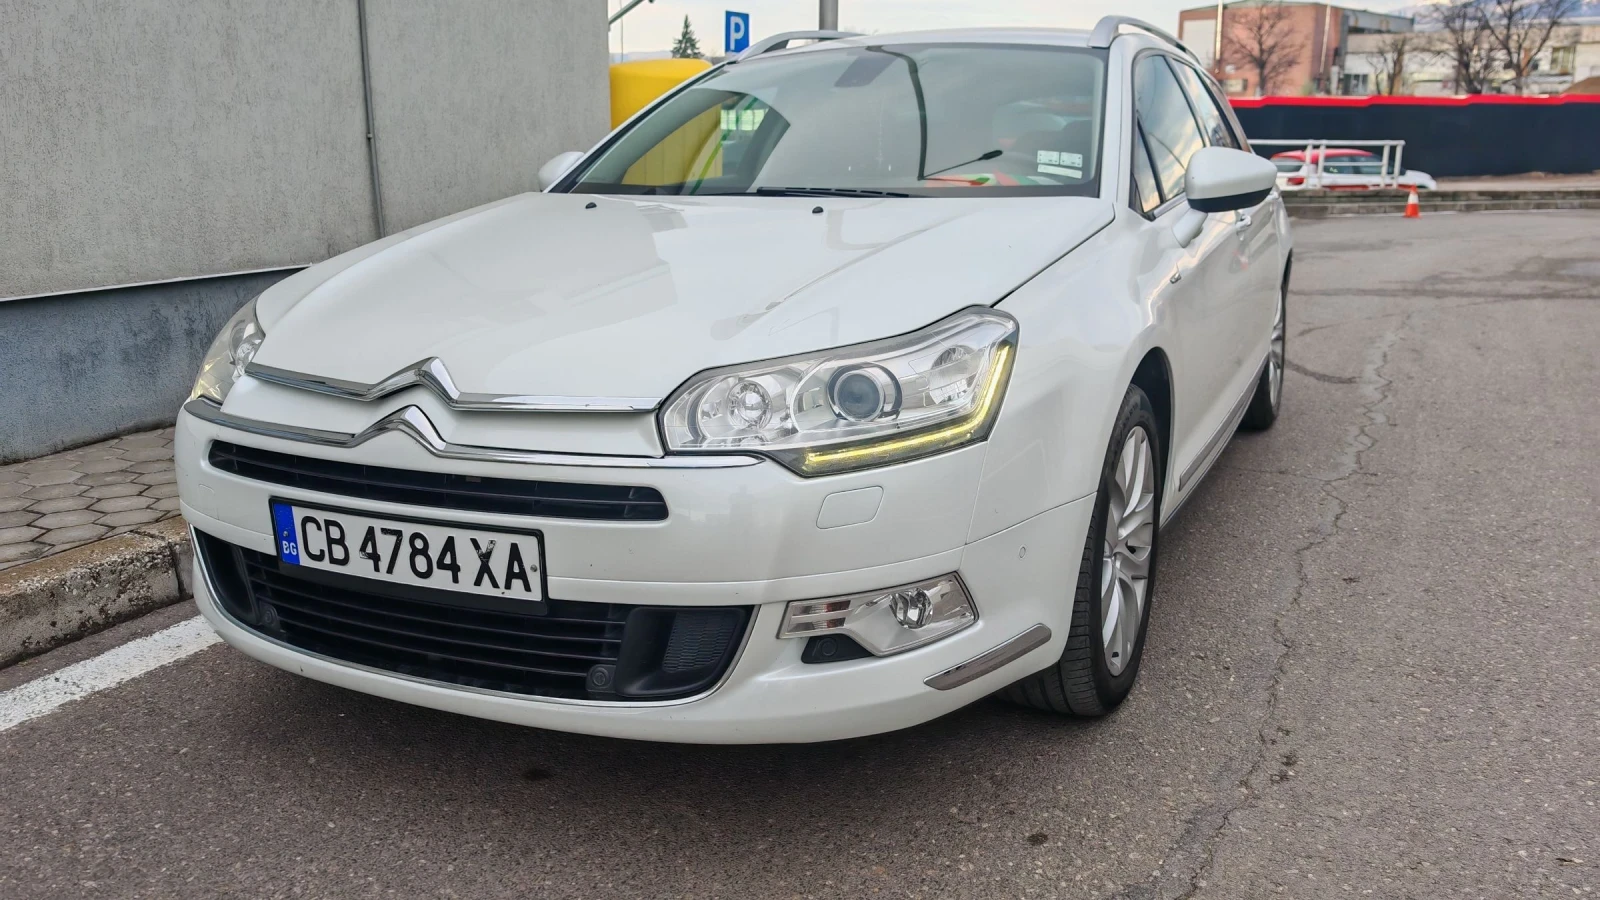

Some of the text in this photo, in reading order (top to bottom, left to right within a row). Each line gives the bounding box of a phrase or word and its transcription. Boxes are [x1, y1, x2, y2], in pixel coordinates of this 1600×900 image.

[730, 16, 745, 50] P
[282, 541, 297, 555] BG
[300, 516, 532, 592] CB 4784 XA
